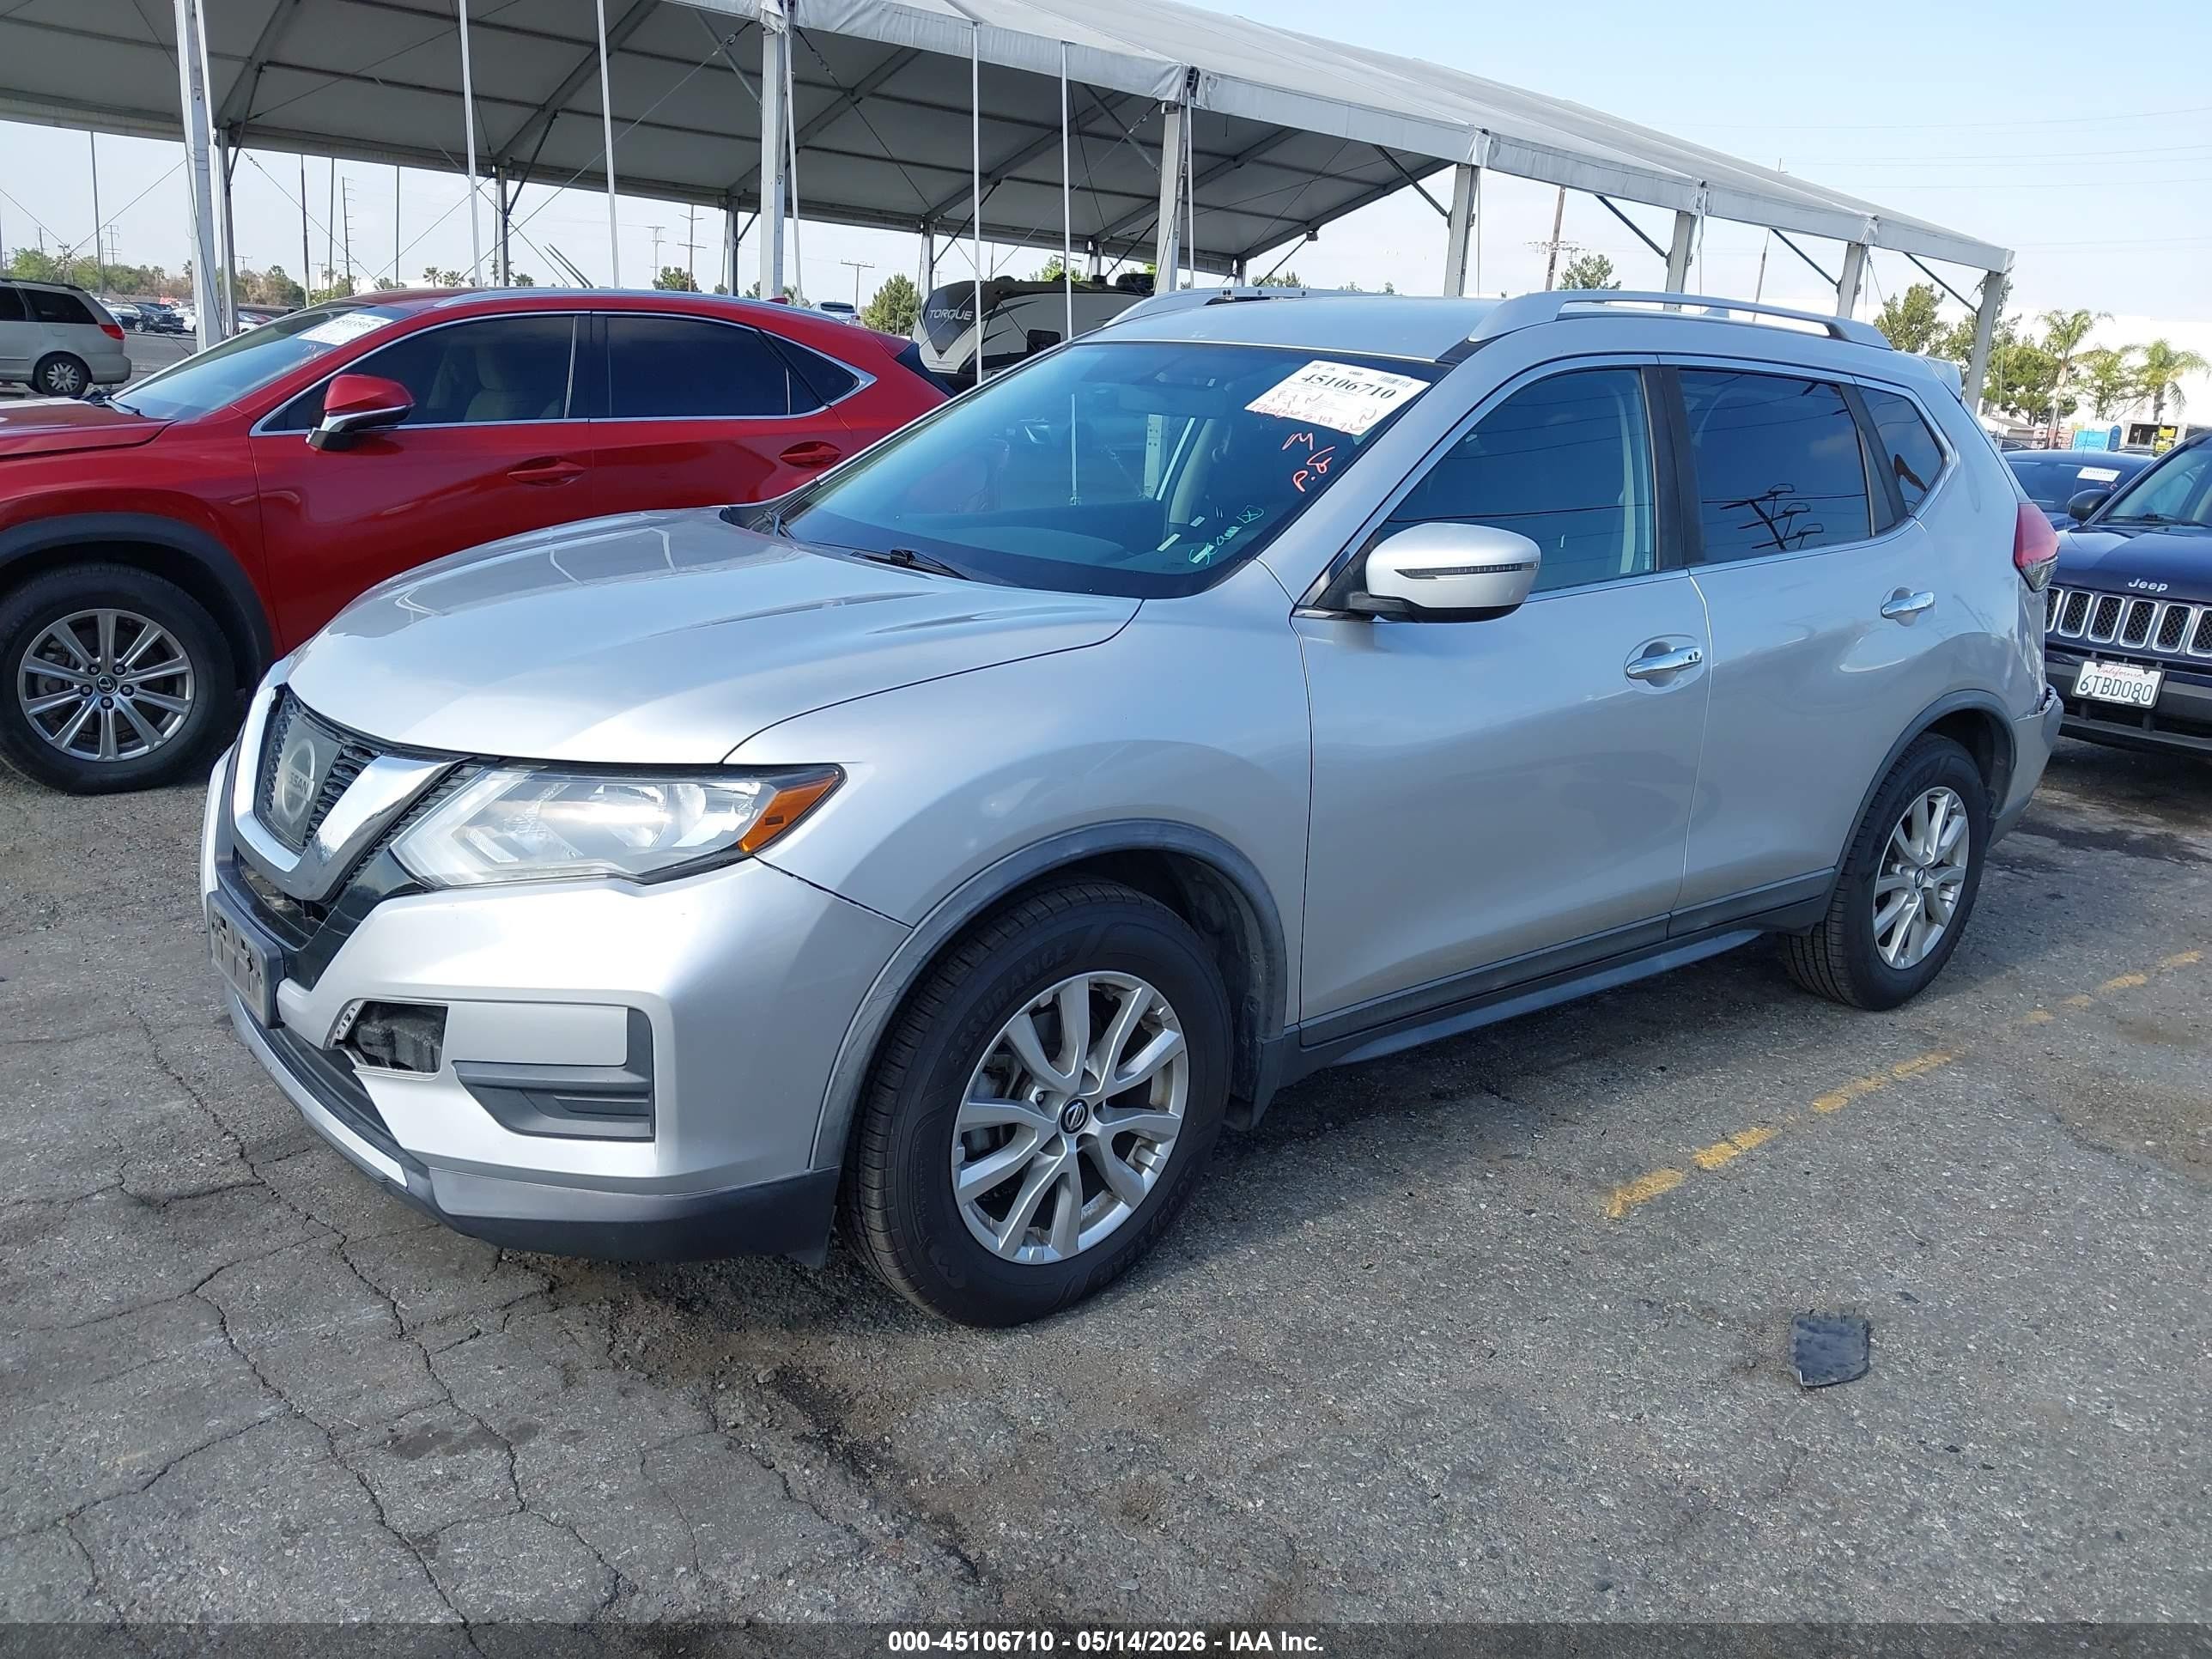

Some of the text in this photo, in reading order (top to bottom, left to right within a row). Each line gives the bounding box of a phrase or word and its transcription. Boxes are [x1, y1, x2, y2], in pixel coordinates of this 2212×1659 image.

[929, 308, 973, 321] TORQUE
[1301, 374, 1397, 399] 45106710
[2128, 578, 2169, 592] Jeep
[2079, 674, 2154, 702] 6TBD080
